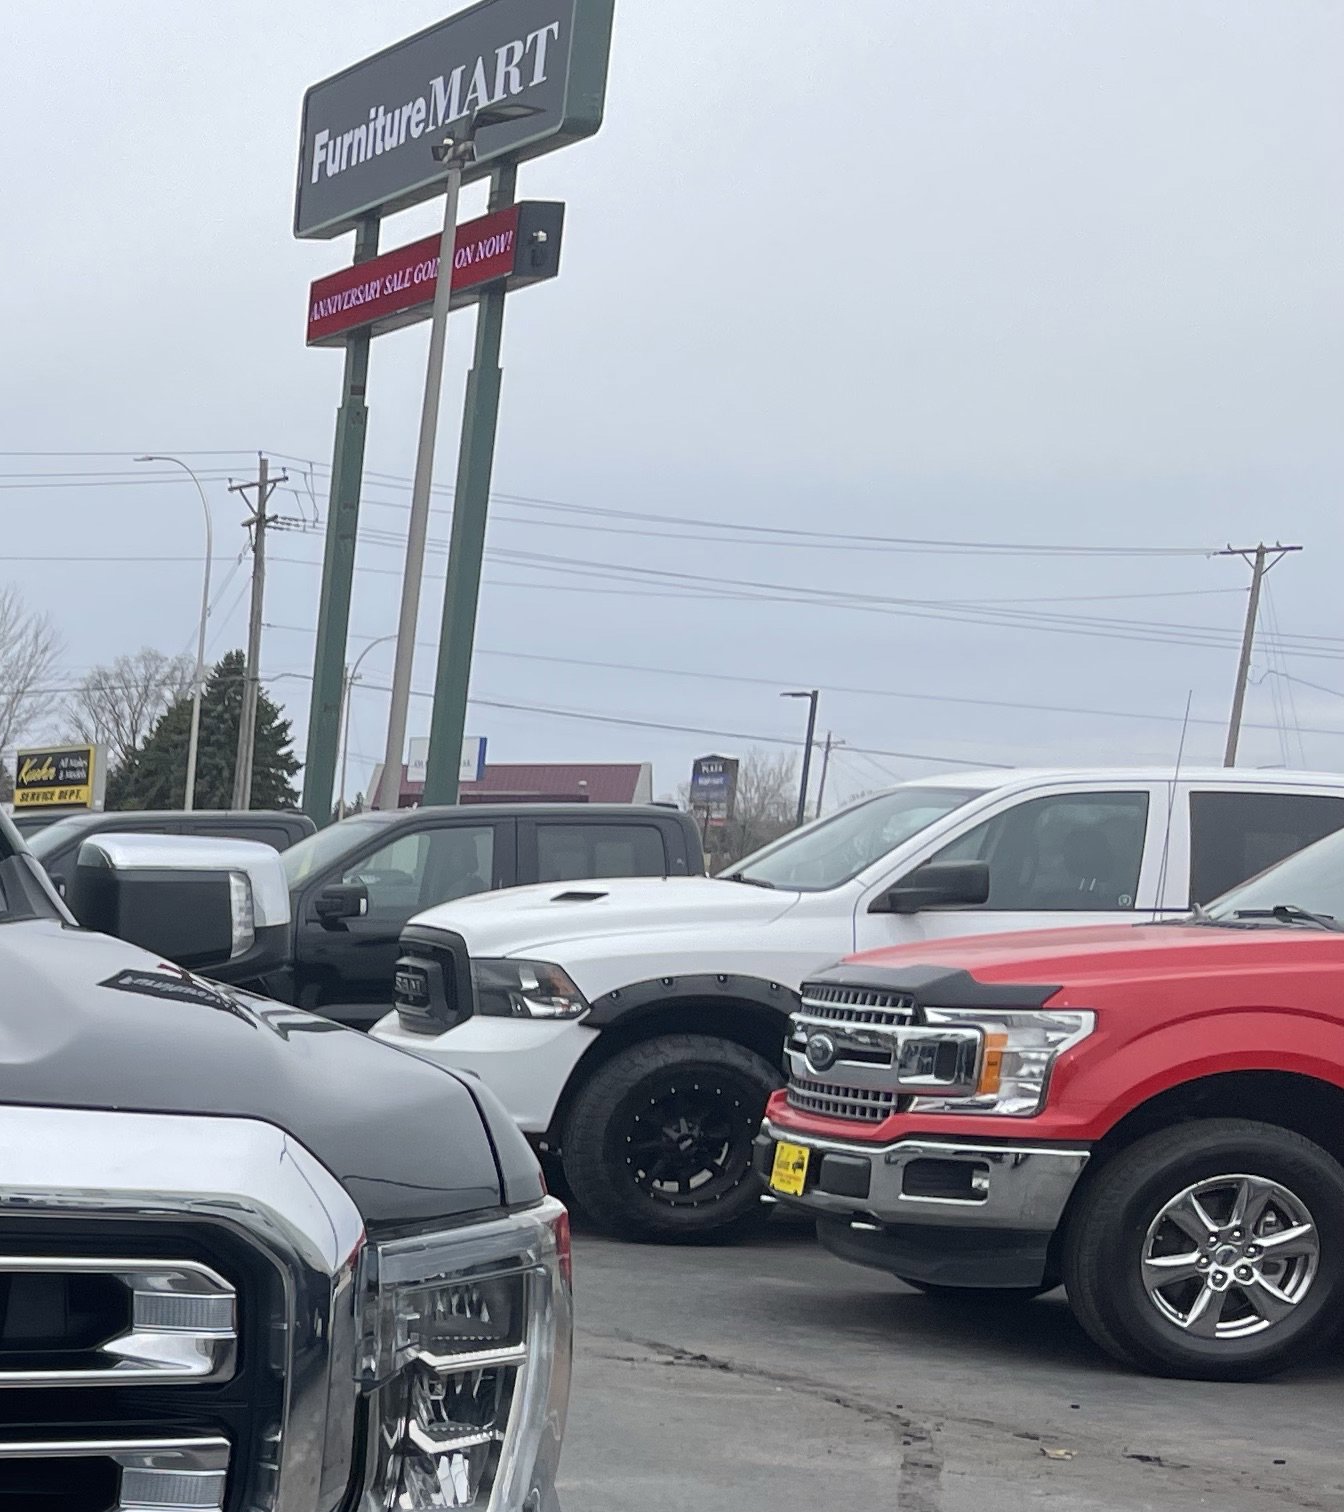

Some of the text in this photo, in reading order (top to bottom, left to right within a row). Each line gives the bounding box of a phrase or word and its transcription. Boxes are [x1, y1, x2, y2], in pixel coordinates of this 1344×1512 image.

[311, 21, 559, 184] FurnitureMART
[309, 277, 384, 322] ANNIVERSARY
[383, 265, 412, 296] SALE
[454, 244, 474, 270] ON
[475, 229, 513, 262] NOW!
[18, 756, 56, 786] Kuehn
[19, 790, 55, 803] SERVICE
